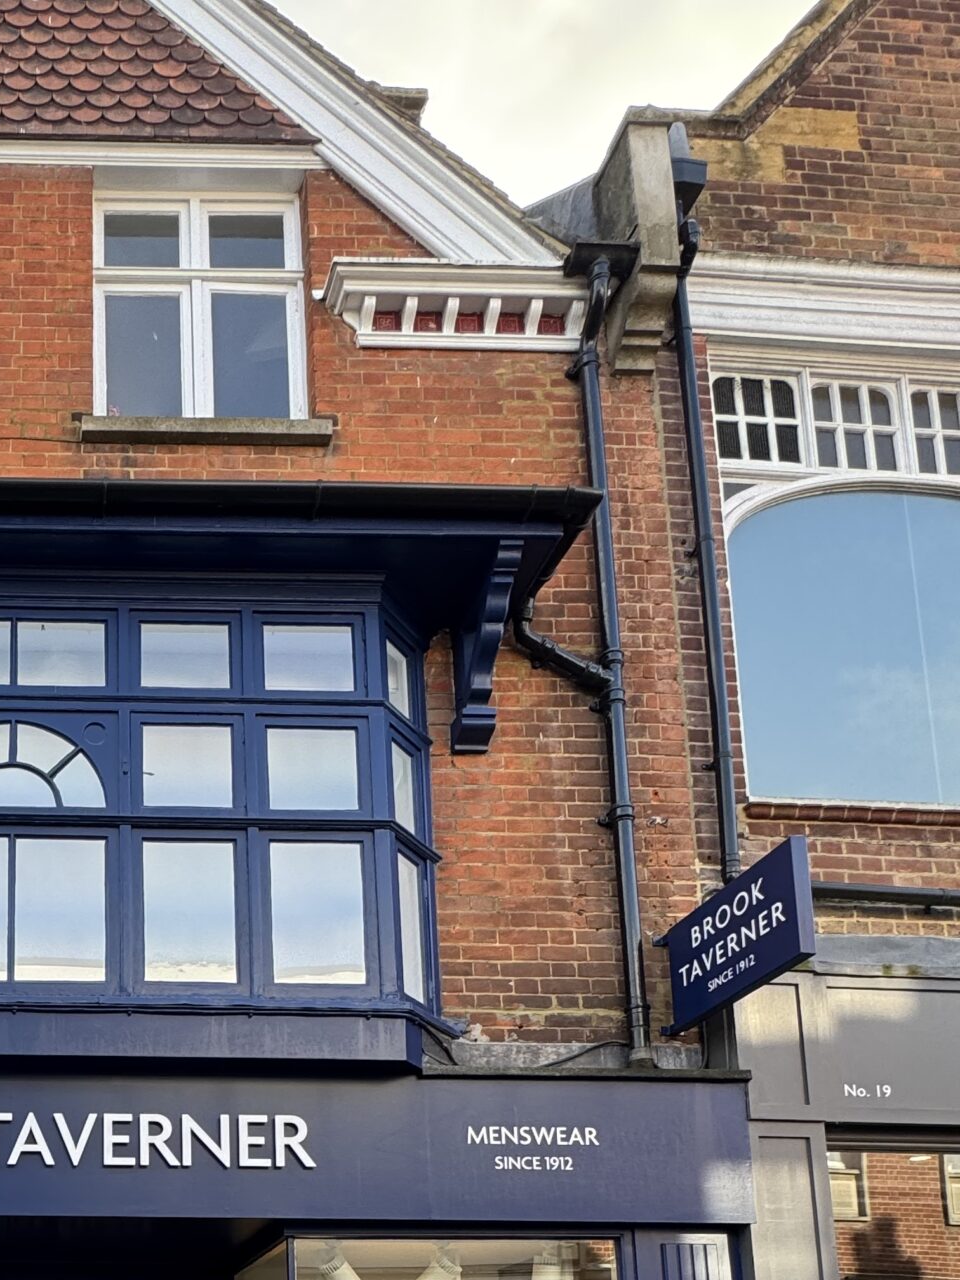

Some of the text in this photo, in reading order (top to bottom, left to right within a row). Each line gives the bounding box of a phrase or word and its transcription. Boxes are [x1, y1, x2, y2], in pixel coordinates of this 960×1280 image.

[690, 877, 765, 948] BROOK
[678, 902, 786, 987] TAVERNER
[707, 954, 756, 992] SINCE 1912
[843, 1083, 892, 1097] No. 19
[467, 1126, 600, 1146] MENSWEAR
[494, 1156, 574, 1170] SINCE 1912
